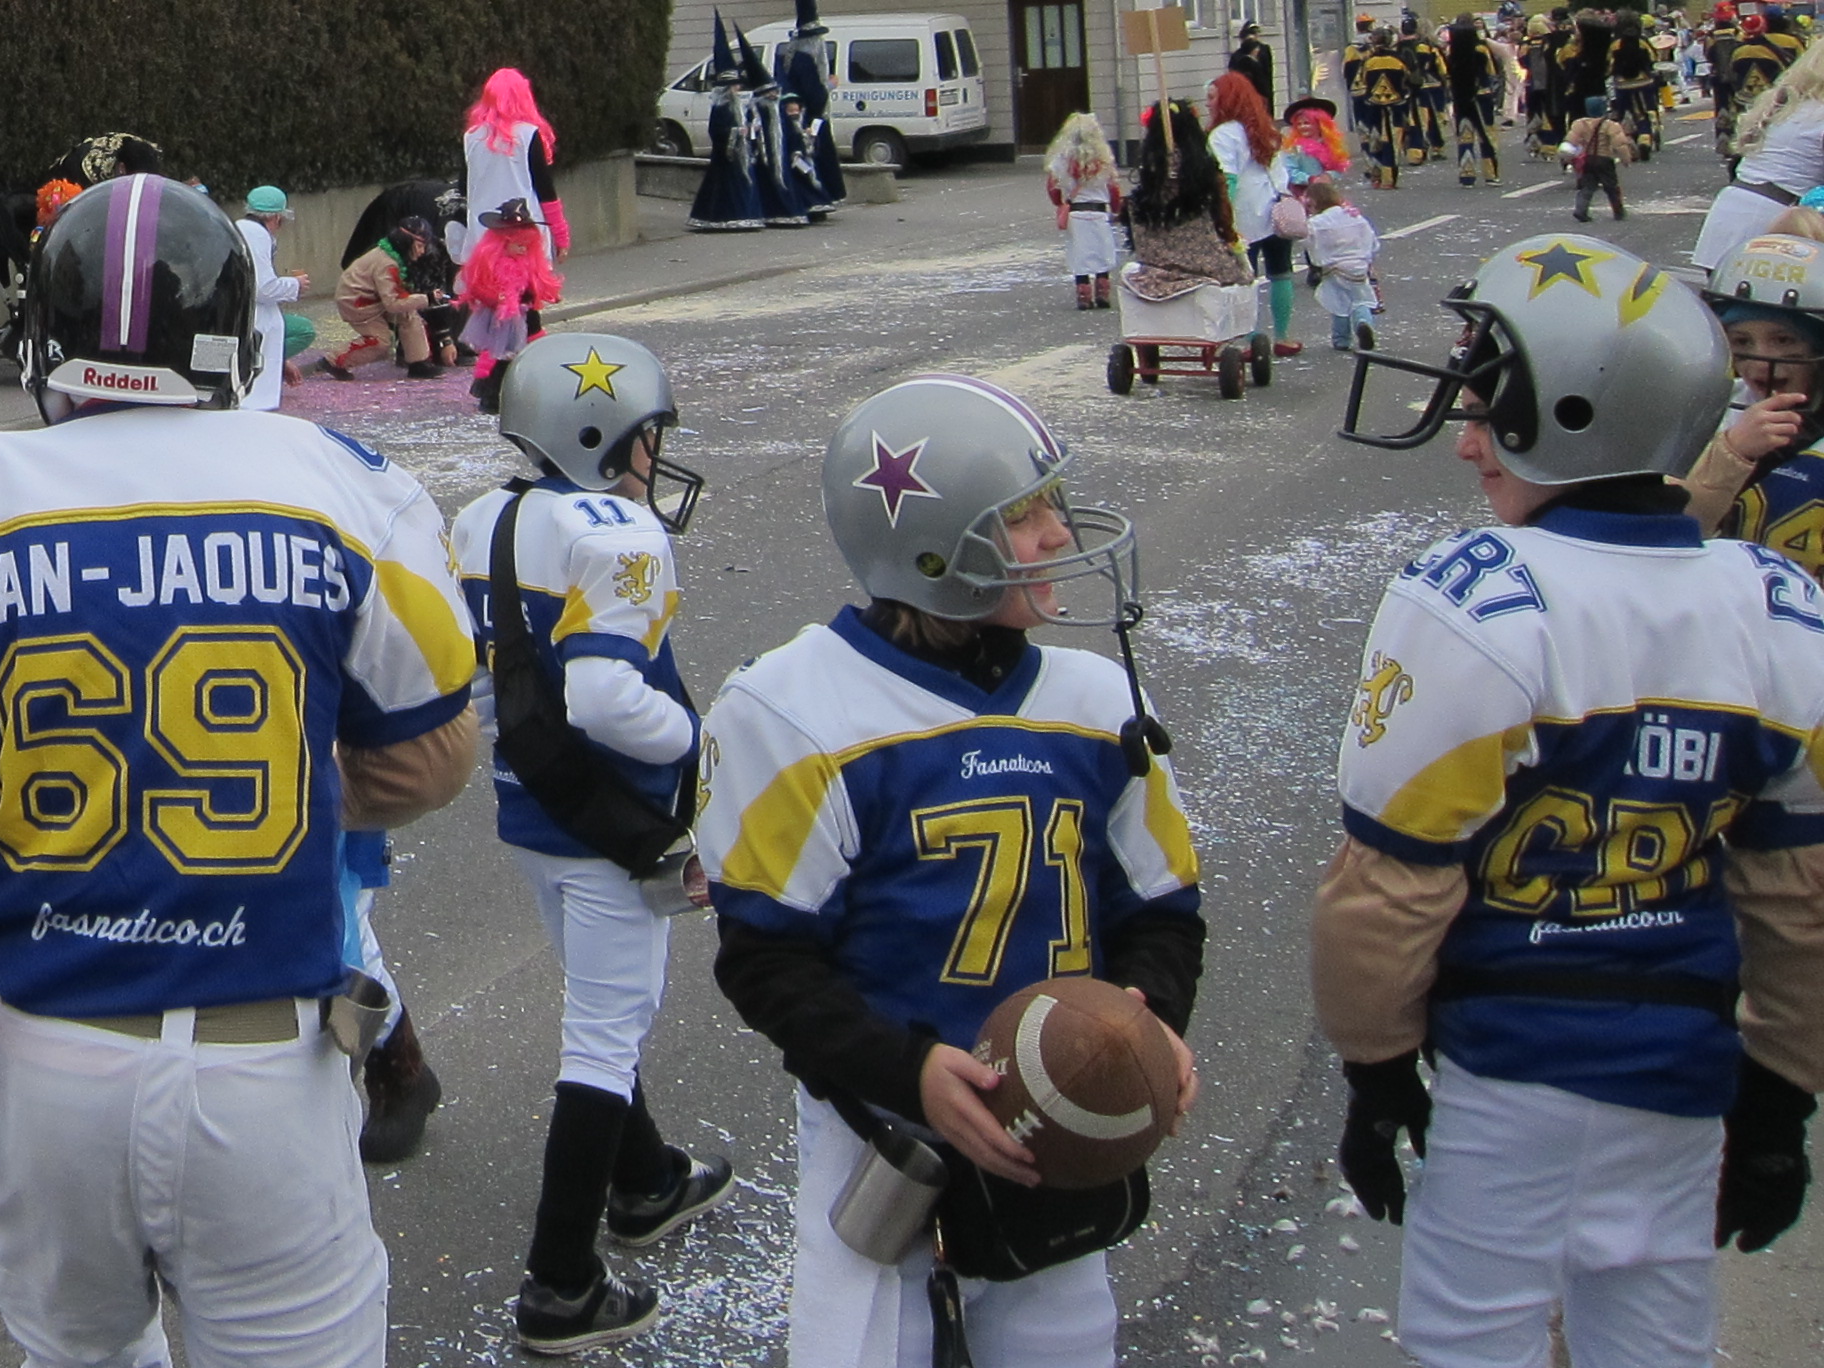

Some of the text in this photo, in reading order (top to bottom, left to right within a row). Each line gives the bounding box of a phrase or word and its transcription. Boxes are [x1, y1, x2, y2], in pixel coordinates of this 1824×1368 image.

[842, 90, 919, 101] REINIGUNGEN
[83, 367, 159, 392] Riddell
[573, 497, 636, 529] 11
[960, 749, 1054, 780] Fasnaticos
[909, 794, 1093, 986] 71
[30, 901, 247, 947] fasnatico.ch
